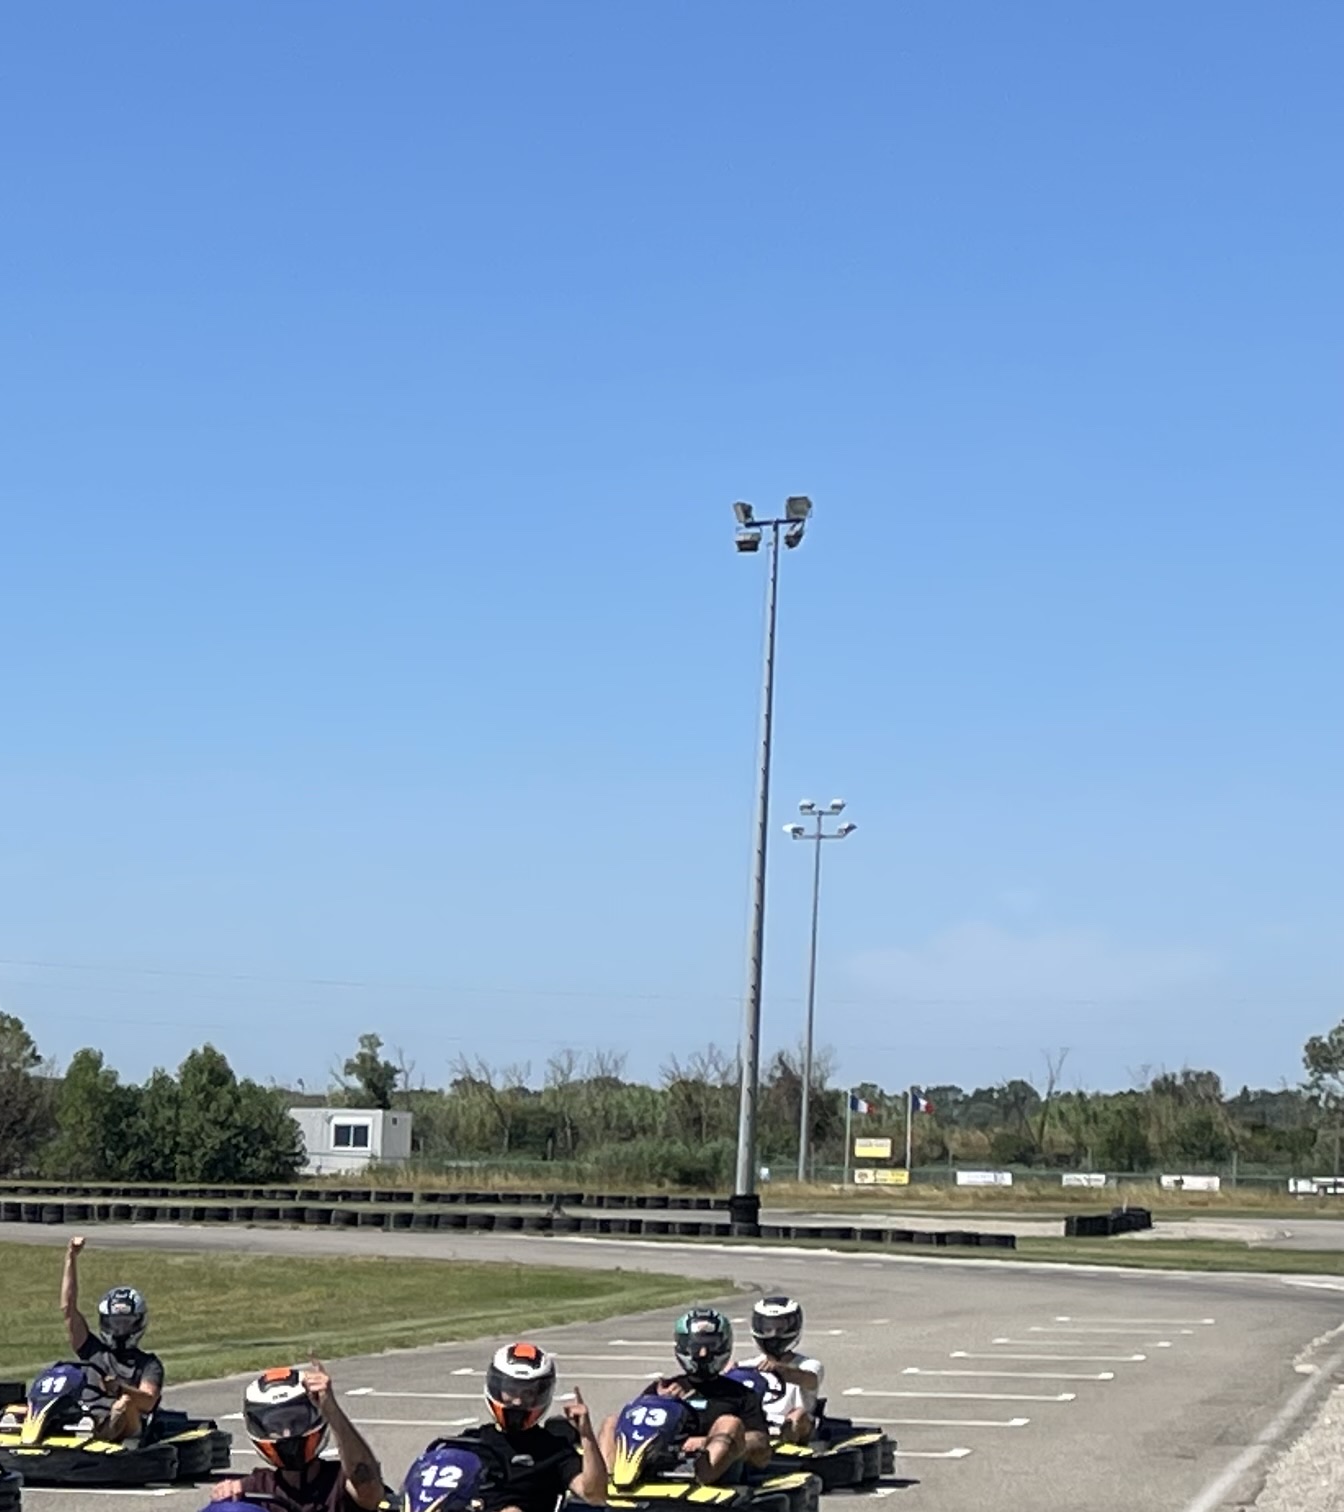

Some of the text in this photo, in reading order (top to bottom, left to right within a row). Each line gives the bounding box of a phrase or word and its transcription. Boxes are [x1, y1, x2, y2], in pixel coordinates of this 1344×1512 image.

[40, 1376, 67, 1393] 11
[631, 1406, 668, 1427] 13
[421, 1465, 463, 1488] 12
